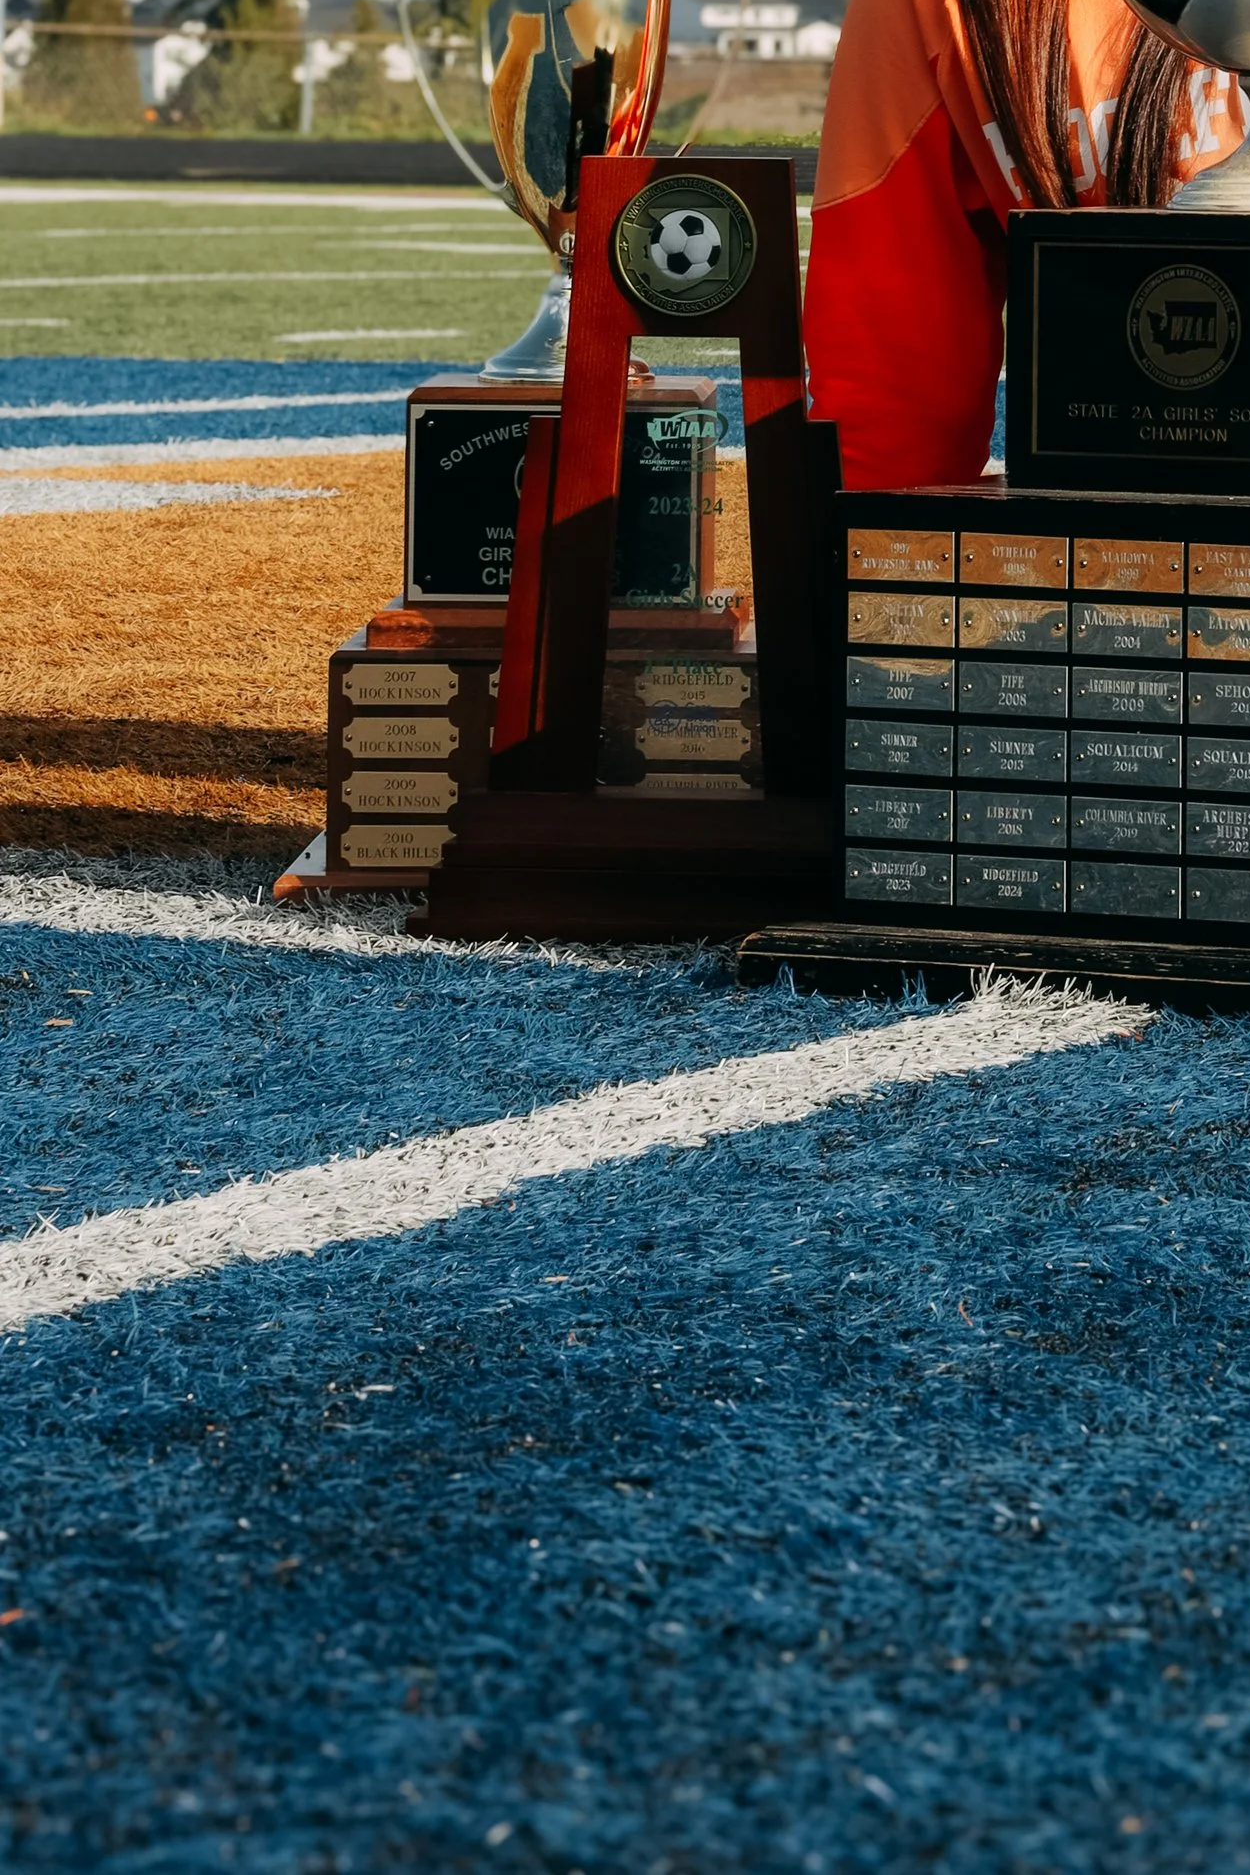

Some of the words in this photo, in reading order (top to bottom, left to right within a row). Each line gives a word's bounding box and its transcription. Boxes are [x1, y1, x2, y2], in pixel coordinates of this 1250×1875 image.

[627, 180, 678, 219] WASHINGTON
[678, 178, 746, 221] INTERSCHOLASTIC
[635, 283, 678, 311] ACTIVITIES
[678, 284, 735, 312] ASSOCIATION
[1068, 403, 1119, 419] STATE
[1131, 406, 1153, 420] 2A
[1164, 406, 1218, 422] GIRLS'
[660, 420, 717, 439] WIAA
[1140, 426, 1227, 442] CHAMPION
[440, 422, 529, 470] SOUTHWES
[649, 496, 723, 516] 2023-24
[486, 527, 517, 540] WIA
[479, 547, 512, 561] GIR
[992, 545, 1037, 560] OTHELLO
[1206, 551, 1234, 564] EAST
[861, 558, 912, 571] RIVERSIDE
[671, 563, 698, 582] 2A
[1116, 567, 1139, 581] 1999
[680, 588, 745, 609] Soccer
[1083, 609, 1127, 627] NACHES
[1131, 612, 1172, 629] VALLEY
[1000, 630, 1027, 642] 2003
[1114, 635, 1141, 650] 2004
[384, 671, 416, 682] 2007
[653, 674, 733, 686] RIDGEFIELD
[889, 669, 913, 683] FIFE
[1001, 675, 1025, 689] FIFE
[1088, 679, 1136, 694] ARCHBISHOP
[359, 688, 441, 700] HOCKINSON
[680, 691, 705, 701] 2015
[886, 687, 915, 701] 2007
[998, 692, 1027, 707] 2008
[1112, 697, 1144, 712] 2009
[384, 724, 417, 736] 2008
[359, 741, 442, 753] HOCKINSON
[881, 733, 918, 748] SUMNER
[680, 743, 705, 753] 2016
[989, 741, 1035, 757] SUMNER
[1087, 743, 1164, 760] SQUALICUM
[888, 751, 910, 764] 2012
[1000, 759, 1024, 772] 2013
[1113, 760, 1138, 773] 2014
[383, 779, 417, 790] 2009
[358, 795, 441, 807] HOCKINSON
[874, 800, 922, 815] LIBERTY
[986, 806, 1035, 821] LIBERTY
[1085, 809, 1133, 824] COLUMBIA
[1137, 811, 1167, 826] RIVER
[887, 817, 910, 830] 2017
[998, 823, 1023, 836] 2018
[384, 832, 414, 844] 2010
[1115, 826, 1138, 839] 2019
[356, 847, 397, 859] BLACK
[402, 848, 440, 859] HILLS
[871, 861, 926, 877] RIDGEFIELD
[982, 867, 1038, 883] RIDGEFIELD
[886, 878, 911, 891] 2023
[998, 884, 1023, 898] 2024
